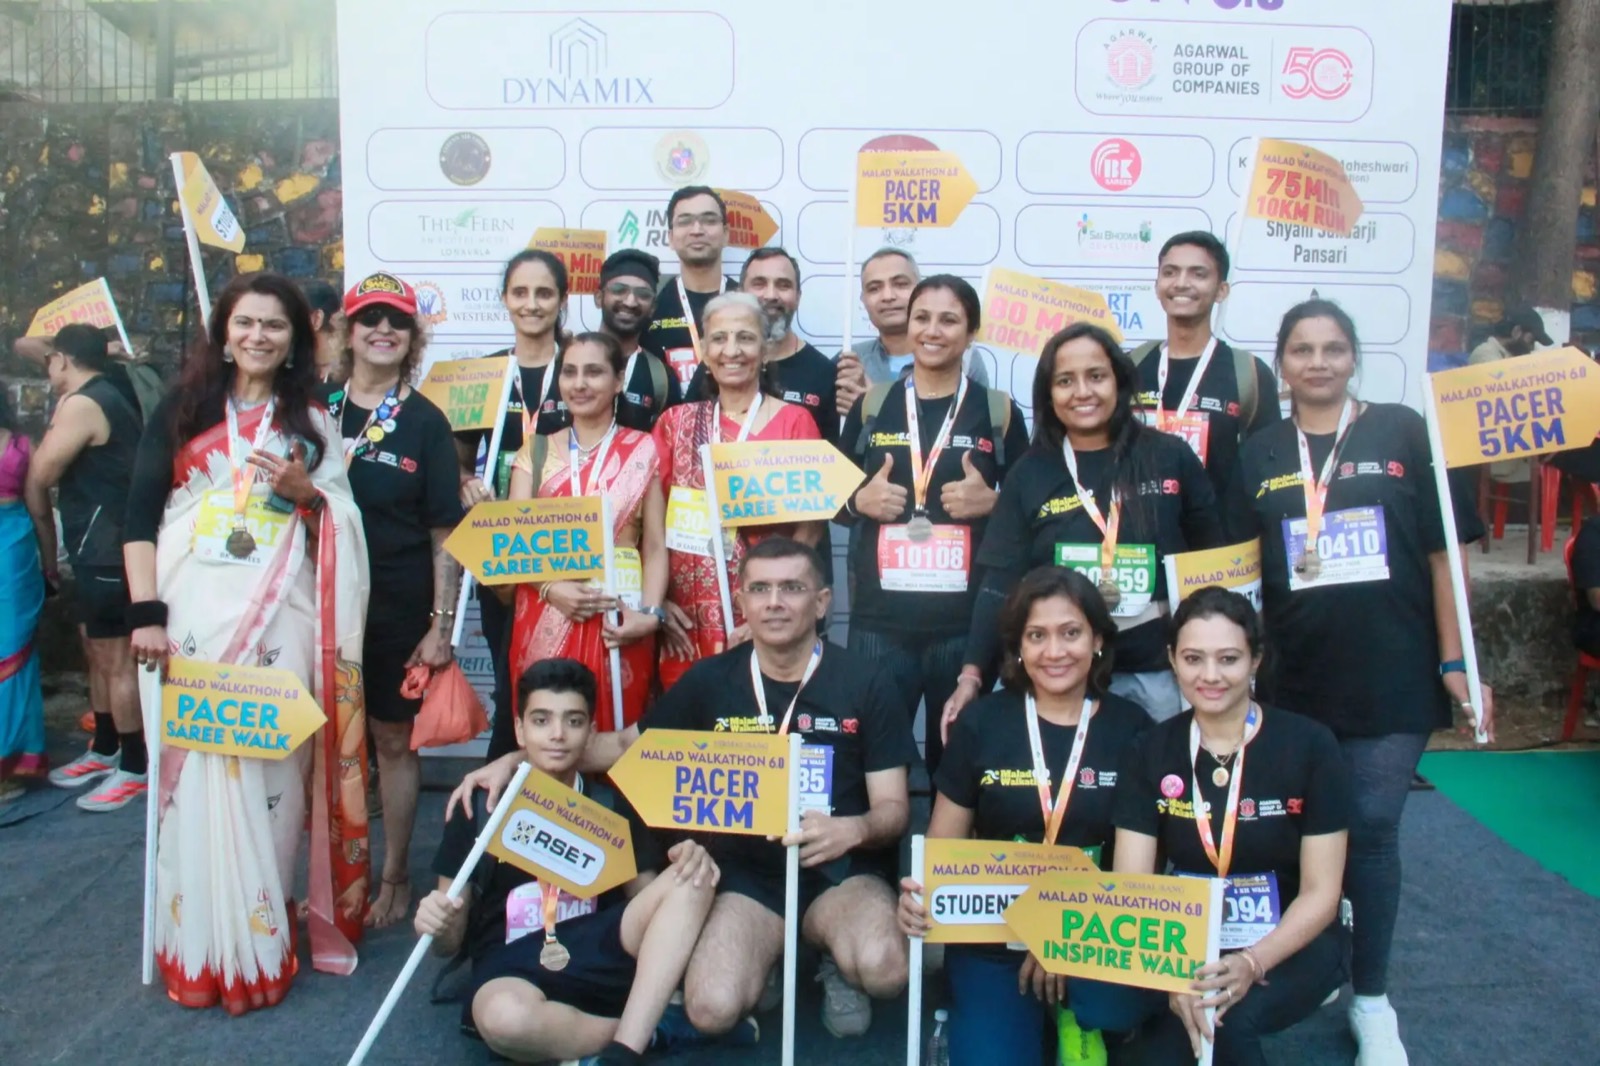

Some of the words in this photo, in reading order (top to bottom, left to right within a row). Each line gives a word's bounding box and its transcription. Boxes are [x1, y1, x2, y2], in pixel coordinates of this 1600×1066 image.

[1173, 43, 1249, 60] AGARWAL
[1173, 62, 1225, 77] GROUP
[1231, 63, 1251, 78] OF
[503, 78, 653, 104] DYNAMIX
[1172, 79, 1261, 95] COMPANIES
[862, 169, 892, 178] MALAD
[893, 167, 946, 178] WALKATHON
[1262, 154, 1296, 167] MALAD
[884, 179, 941, 201] PACER
[1266, 167, 1302, 199] 75
[471, 215, 515, 232] FERN
[883, 202, 938, 224] 5KM
[1256, 195, 1310, 223] 10KM
[1312, 203, 1347, 233] RUN
[440, 249, 491, 257] LONAVALA
[1293, 244, 1348, 264] Pansari
[460, 287, 502, 302] ROTA
[994, 282, 1029, 298] MALAD
[1031, 288, 1091, 316] WALKATHON
[1108, 293, 1132, 311] RT
[453, 312, 501, 322] WESTERN
[988, 296, 1028, 326] 80
[985, 323, 1039, 353] 10KM
[448, 383, 490, 407] PACER
[1440, 386, 1483, 404] MALAD
[1485, 370, 1567, 394] WALKATHON
[1475, 386, 1566, 428] PACER
[1477, 417, 1567, 458] 5KM
[714, 459, 751, 472] MALAD
[754, 454, 820, 467] WALKATHON
[727, 468, 824, 501] PACER
[720, 499, 778, 521] SAREE
[782, 493, 838, 513] WALK
[472, 517, 511, 529] MALAD
[513, 513, 582, 526] WALKATHON
[491, 528, 592, 558] PACER
[1317, 528, 1380, 561] 0410
[482, 557, 543, 577] SAREE
[548, 554, 604, 573] WALK
[894, 544, 964, 570] 10108
[1183, 570, 1224, 586] MALAD
[166, 676, 206, 691] MALAD
[210, 680, 282, 698] WALKATHON
[177, 693, 280, 731] PACER
[166, 720, 225, 745] SAREE
[231, 728, 291, 751] WALK
[640, 749, 685, 762] MALAD
[687, 750, 767, 767] WALKATHON
[768, 756, 785, 769] 6.0
[674, 765, 760, 799] PACER
[519, 788, 555, 811] MALAD
[556, 804, 612, 843] WALKATHON
[672, 795, 754, 829] 5KM
[533, 829, 597, 870] RSET
[932, 864, 980, 876] MALAD
[1038, 890, 1089, 904] MALAD
[1092, 893, 1182, 914] WALKATHON
[1184, 902, 1203, 917] 6.0
[1061, 908, 1189, 956] PACER
[1043, 939, 1134, 971] INSPIRE
[1138, 950, 1207, 981] WALK
